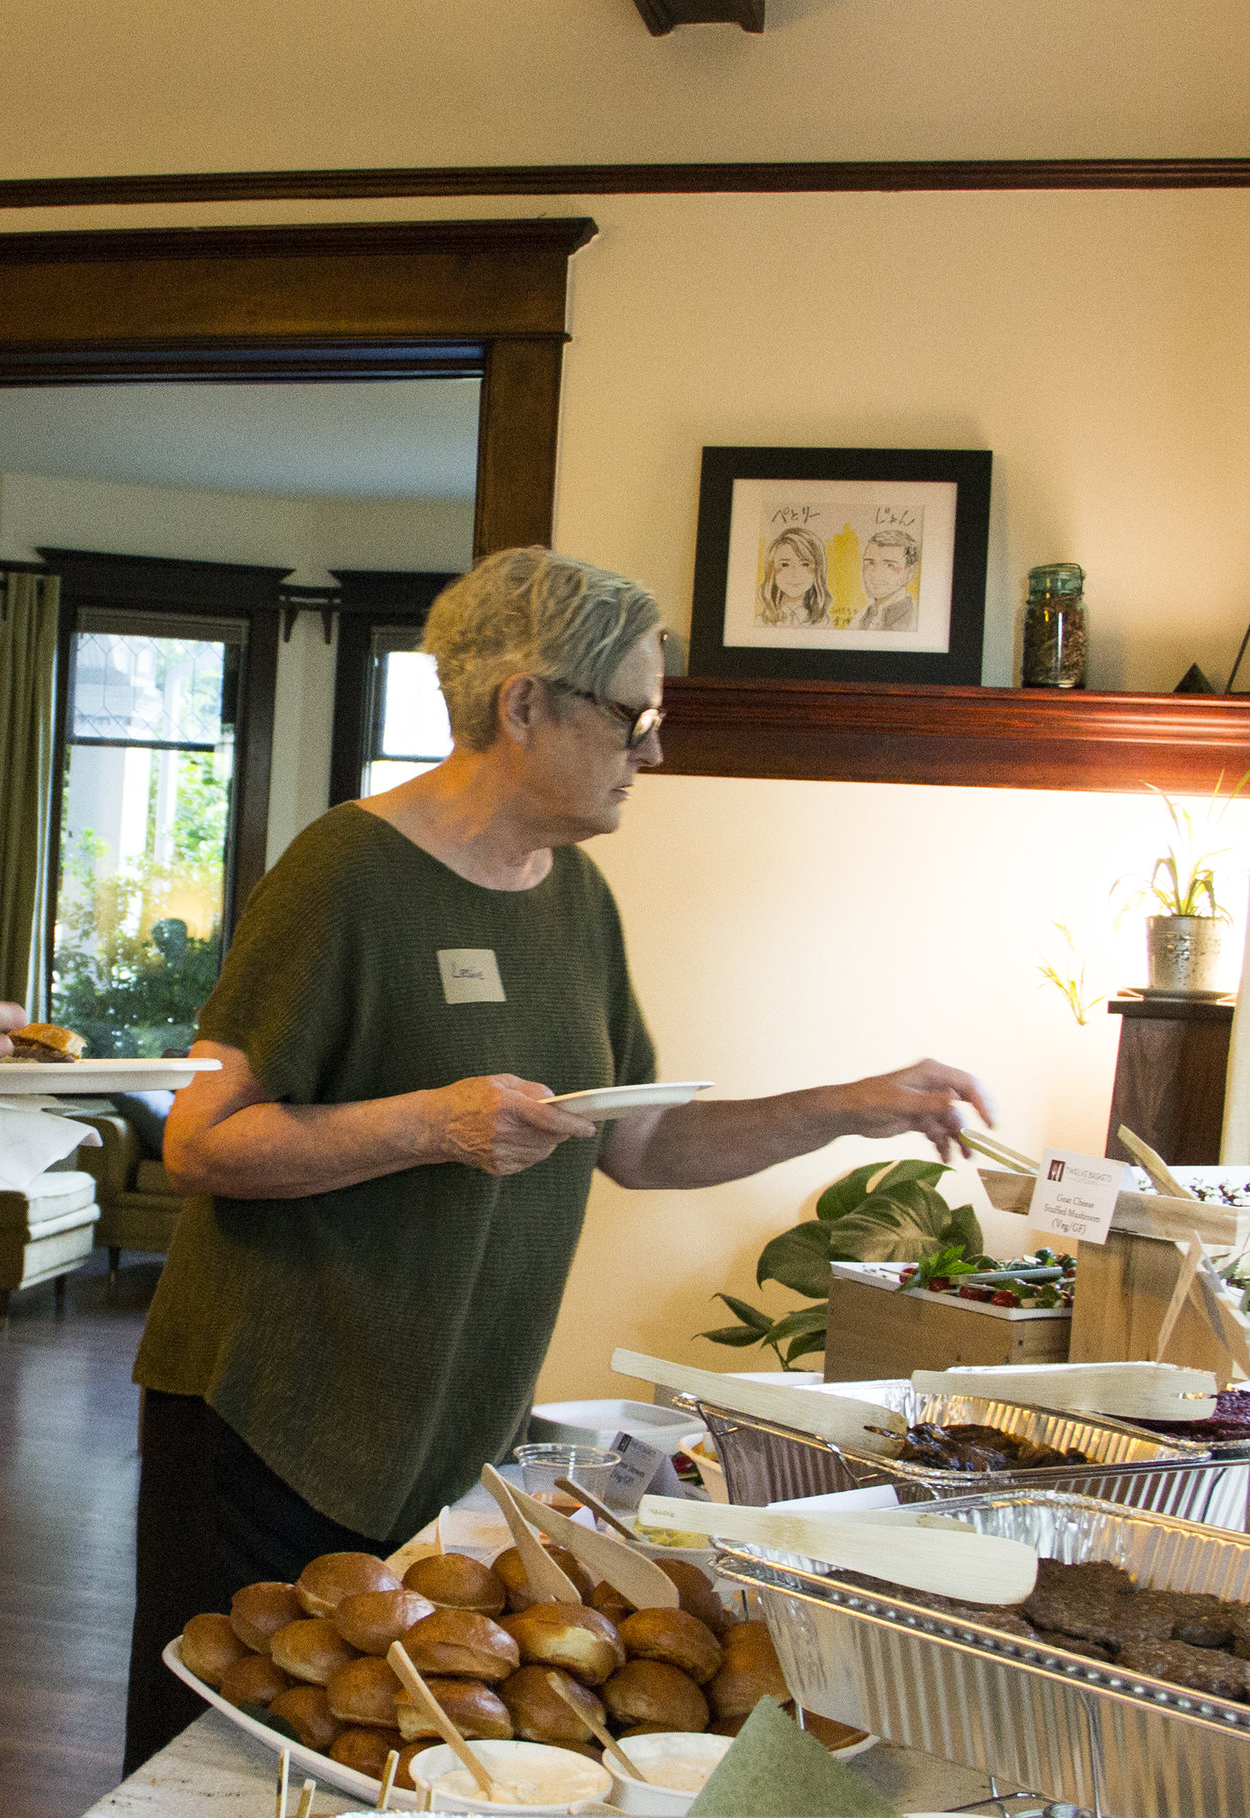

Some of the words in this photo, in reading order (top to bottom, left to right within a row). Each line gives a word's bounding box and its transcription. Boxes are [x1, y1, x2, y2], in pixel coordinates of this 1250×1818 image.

[1073, 1197, 1095, 1208] Cheese
[1043, 1203, 1067, 1216] Stuffed
[1067, 1209, 1101, 1223] Mushroom
